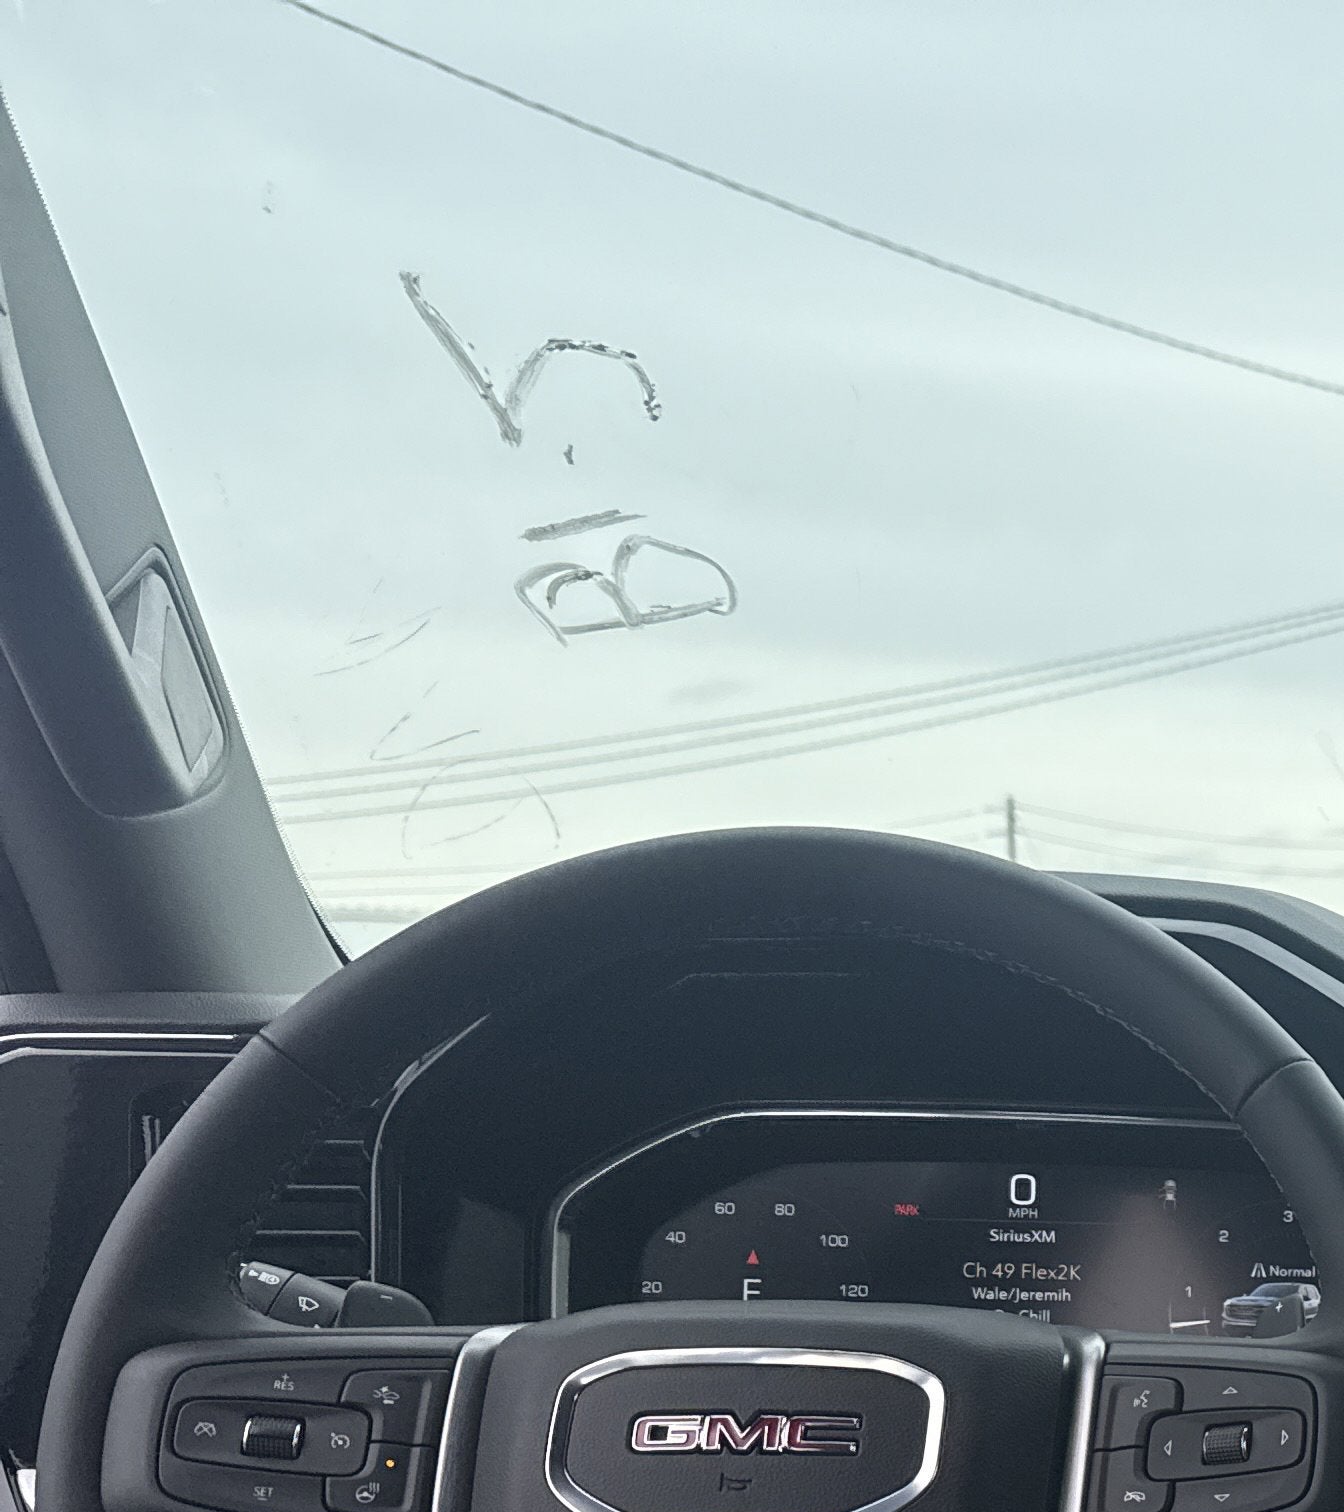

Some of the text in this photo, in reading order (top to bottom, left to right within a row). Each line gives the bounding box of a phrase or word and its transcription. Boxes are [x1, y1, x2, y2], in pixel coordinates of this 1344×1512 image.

[1010, 1173, 1036, 1205] 0
[714, 1202, 736, 1215] 60
[774, 1203, 796, 1216] 80
[1008, 1208, 1038, 1219] MPH
[1283, 1210, 1294, 1223] 3
[665, 1230, 687, 1243] 40
[819, 1234, 849, 1248] 100
[989, 1228, 1056, 1243] SiriusXM
[1218, 1230, 1229, 1243] 2
[963, 1262, 1082, 1281] Ch 49 Flex2K
[1269, 1265, 1316, 1277] Normal
[641, 1281, 662, 1294] 20
[839, 1284, 869, 1297] 120
[1184, 1286, 1192, 1298] 1
[972, 1287, 1071, 1303] Wale/Jeremih
[273, 1379, 295, 1392] RES
[631, 1413, 861, 1452] GMC
[253, 1486, 274, 1498] SET
